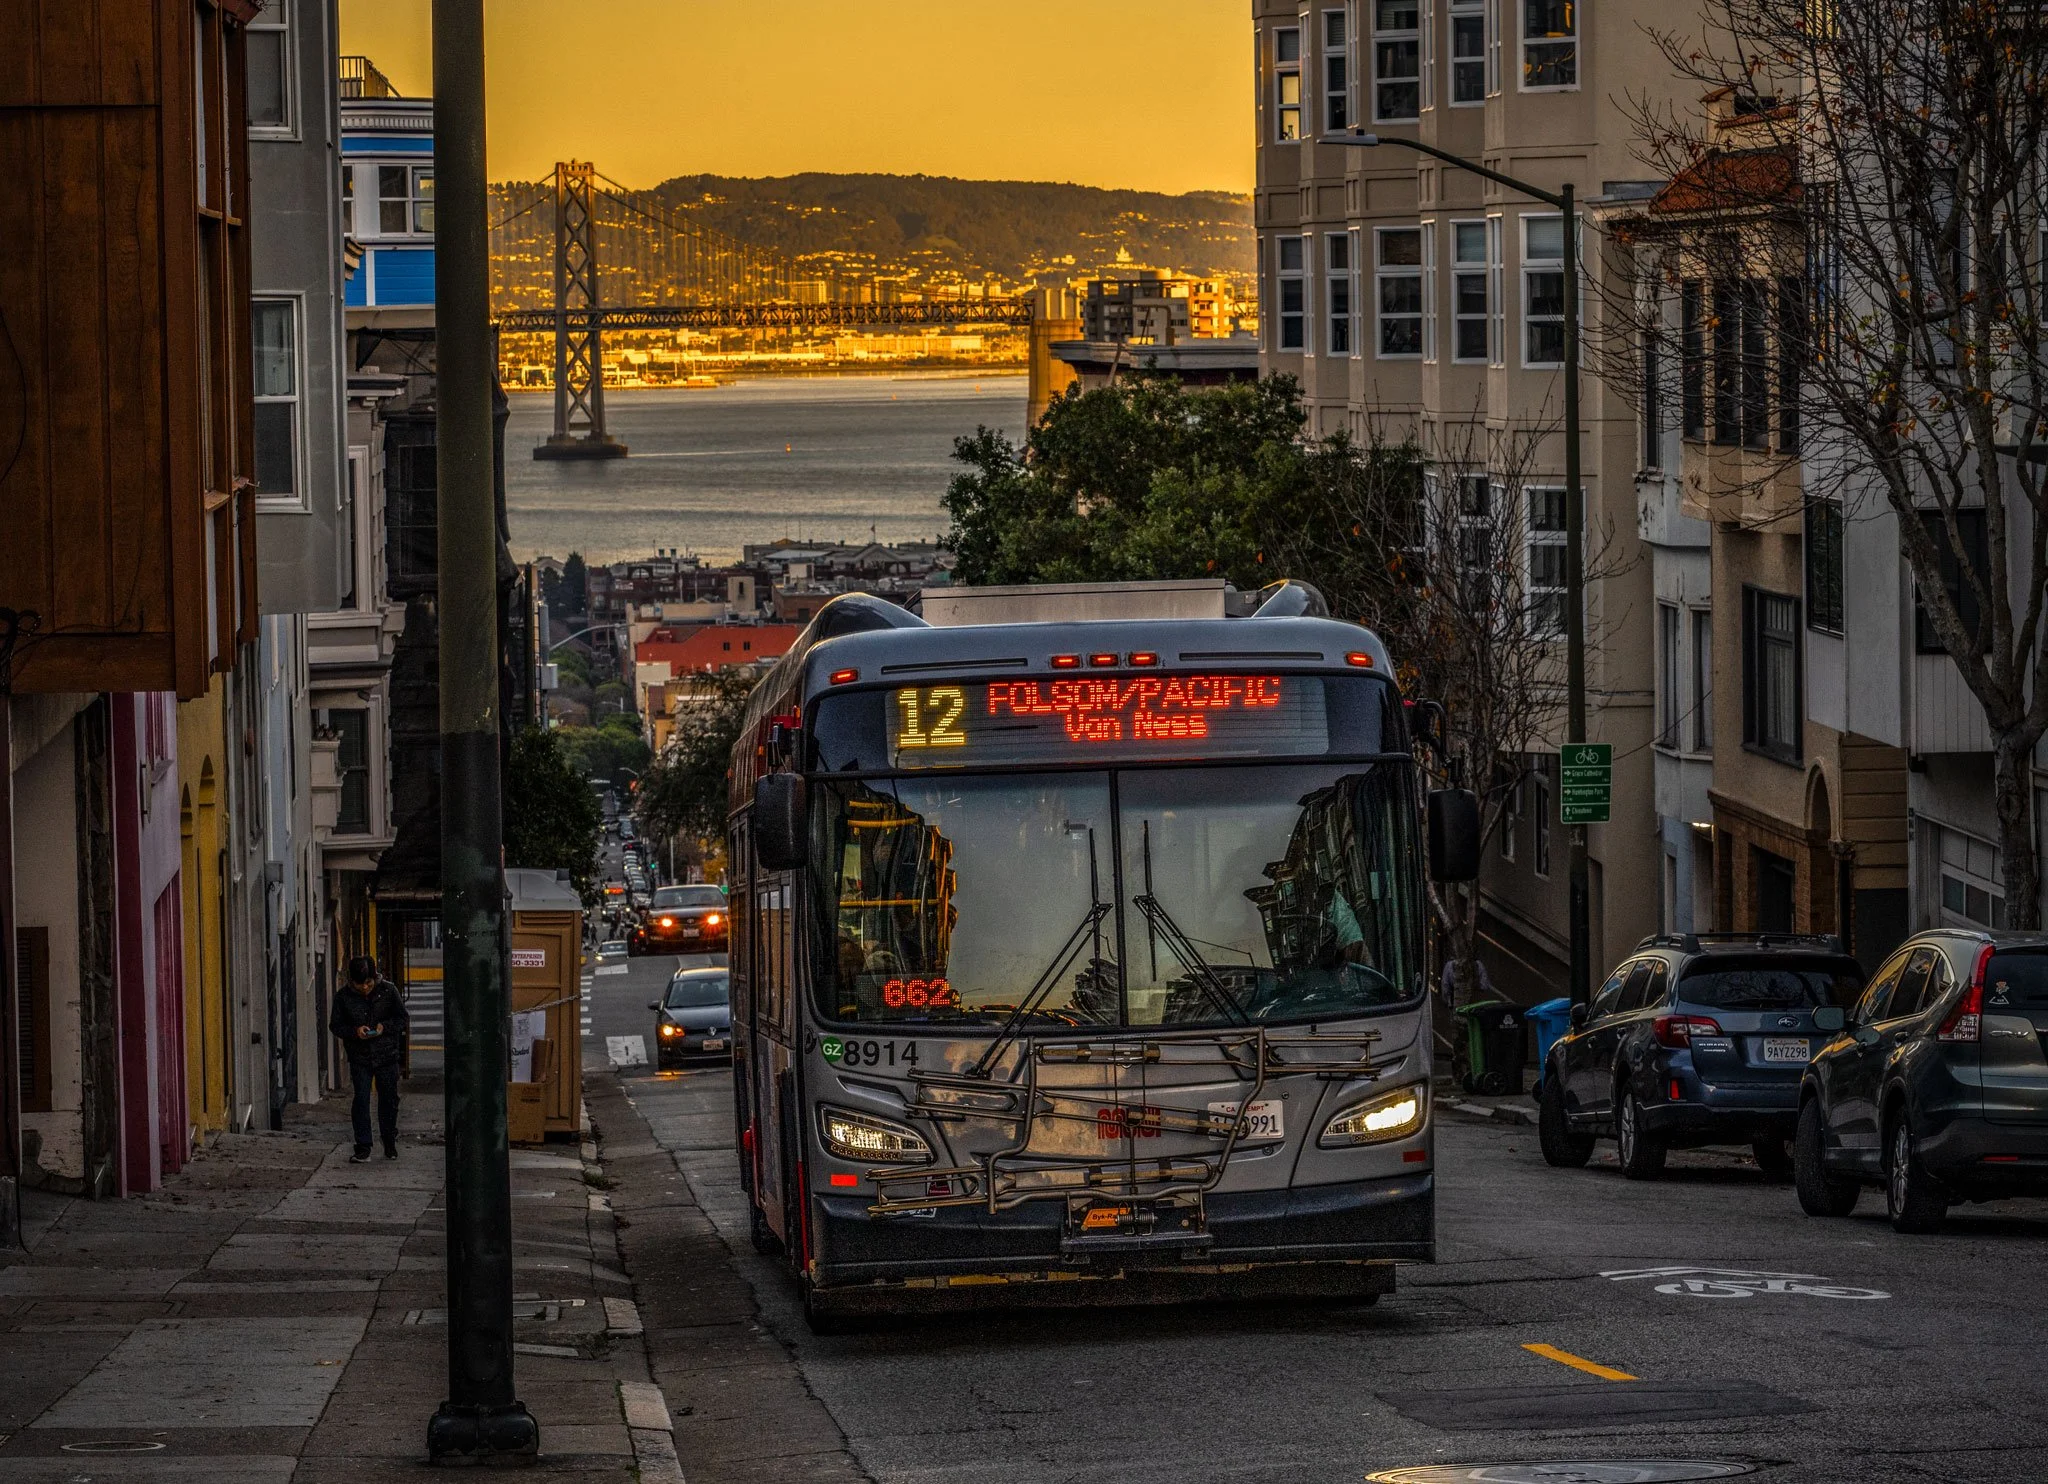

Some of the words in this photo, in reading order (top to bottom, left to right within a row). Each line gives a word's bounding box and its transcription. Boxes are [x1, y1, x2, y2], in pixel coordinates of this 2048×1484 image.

[989, 677, 1280, 713] FOLSOM/PACIFIC
[900, 689, 965, 745] 12
[1066, 713, 1121, 740] Van
[1134, 712, 1207, 738] Ness
[884, 978, 950, 1007] 662
[822, 1043, 842, 1056] GZ
[843, 1041, 919, 1066] 8914
[1767, 1046, 1808, 1058] 9AYZ298
[1092, 1212, 1118, 1221] Byk-Ra
